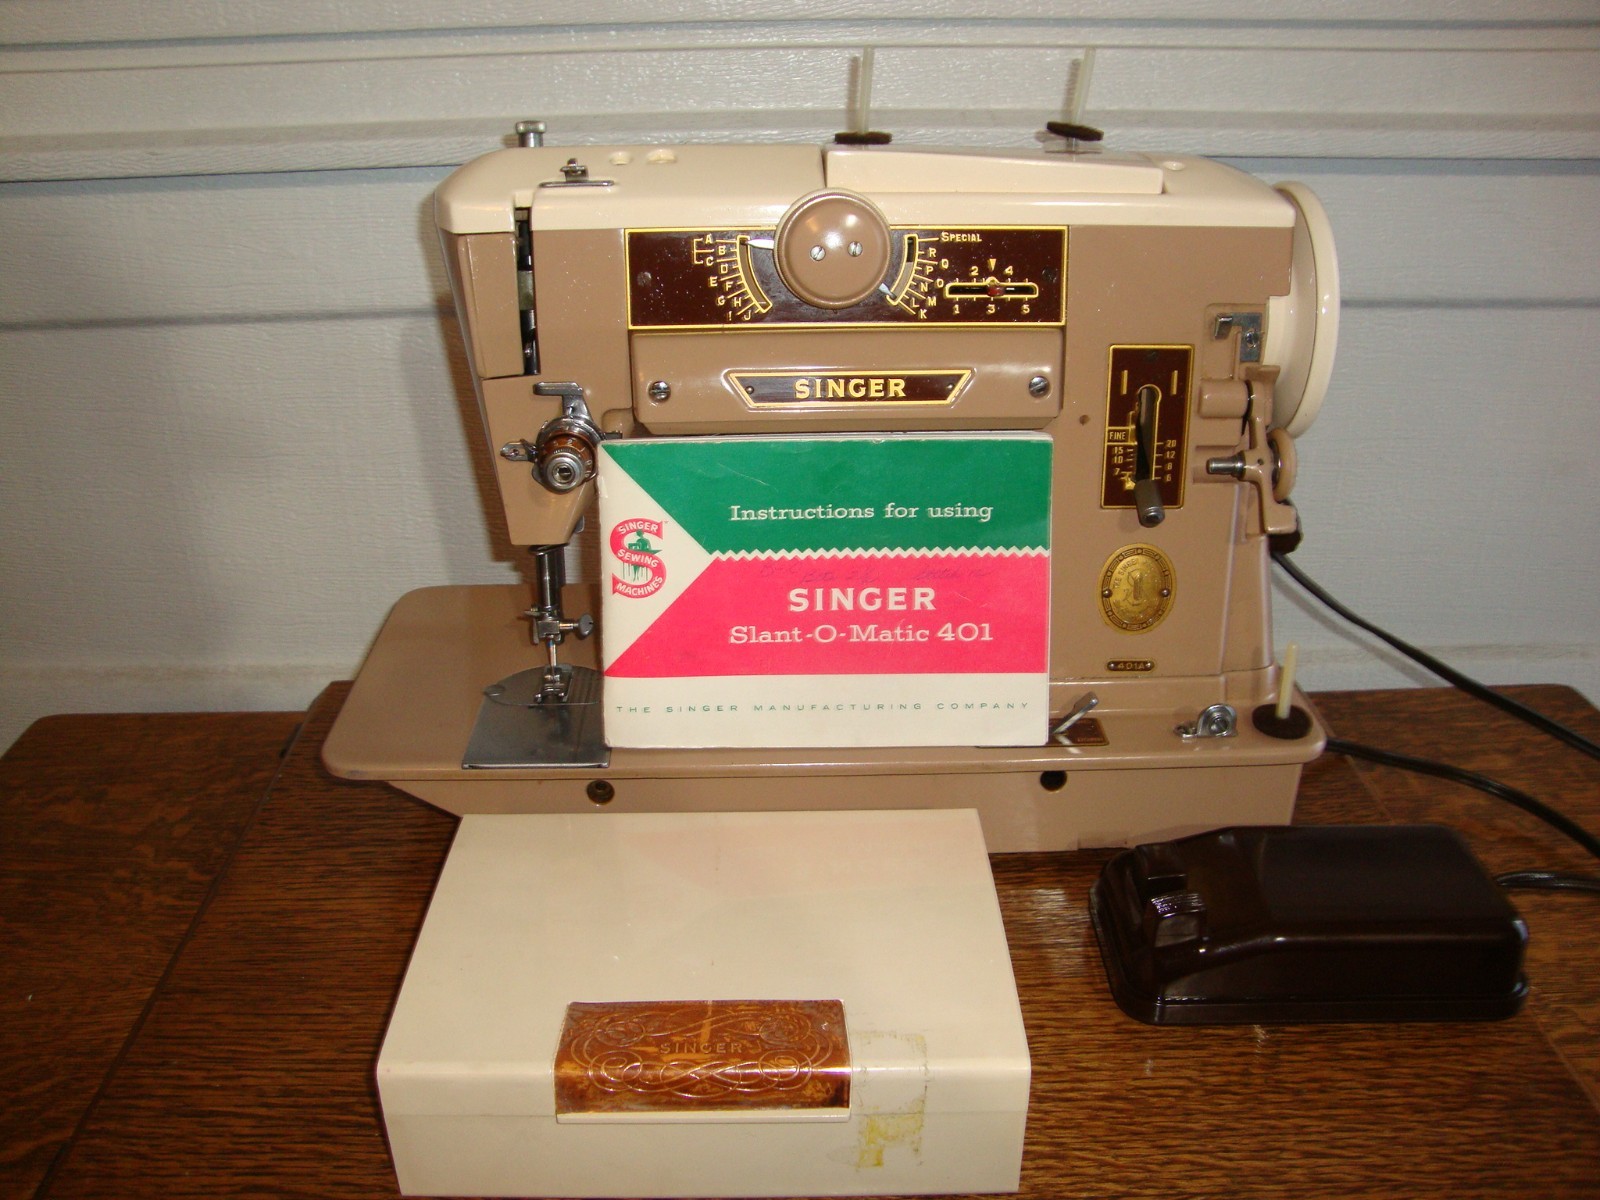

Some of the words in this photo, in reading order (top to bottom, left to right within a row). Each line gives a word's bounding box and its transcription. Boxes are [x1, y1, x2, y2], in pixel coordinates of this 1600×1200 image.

[705, 233, 713, 244] A
[718, 244, 726, 256] B
[928, 247, 937, 258] R
[706, 256, 714, 267] C
[940, 258, 949, 269] Q
[720, 263, 728, 274] D
[925, 265, 934, 275] P
[970, 265, 979, 276] 2
[1004, 265, 1013, 276] 4
[709, 276, 718, 287] E
[725, 281, 733, 292] F
[920, 282, 928, 292] N
[717, 295, 726, 306] G
[733, 296, 742, 307] H
[912, 297, 920, 308] L
[927, 296, 937, 307] M
[919, 308, 928, 319] K
[953, 304, 960, 314] 1
[986, 304, 996, 314] 3
[1021, 304, 1030, 314] 5
[743, 309, 752, 321] J
[795, 378, 907, 399] SINGER
[1109, 431, 1126, 440] FINE
[1113, 446, 1123, 455] 15
[729, 503, 875, 521] Instructions
[884, 502, 920, 519] for
[928, 502, 995, 523] using
[618, 521, 659, 534] SINGER
[617, 549, 659, 568] SEWING
[616, 576, 663, 596] MACHINES
[788, 587, 937, 612] SINGER
[729, 623, 930, 644] Slant-O-Matic
[937, 622, 994, 642] 401
[1117, 662, 1145, 670] 401A
[616, 705, 651, 714] THE
[666, 704, 738, 714] SINGER
[753, 703, 922, 712] MANUFACTURING
[936, 702, 1029, 711] COMPANY
[660, 1041, 743, 1055] SINGER
